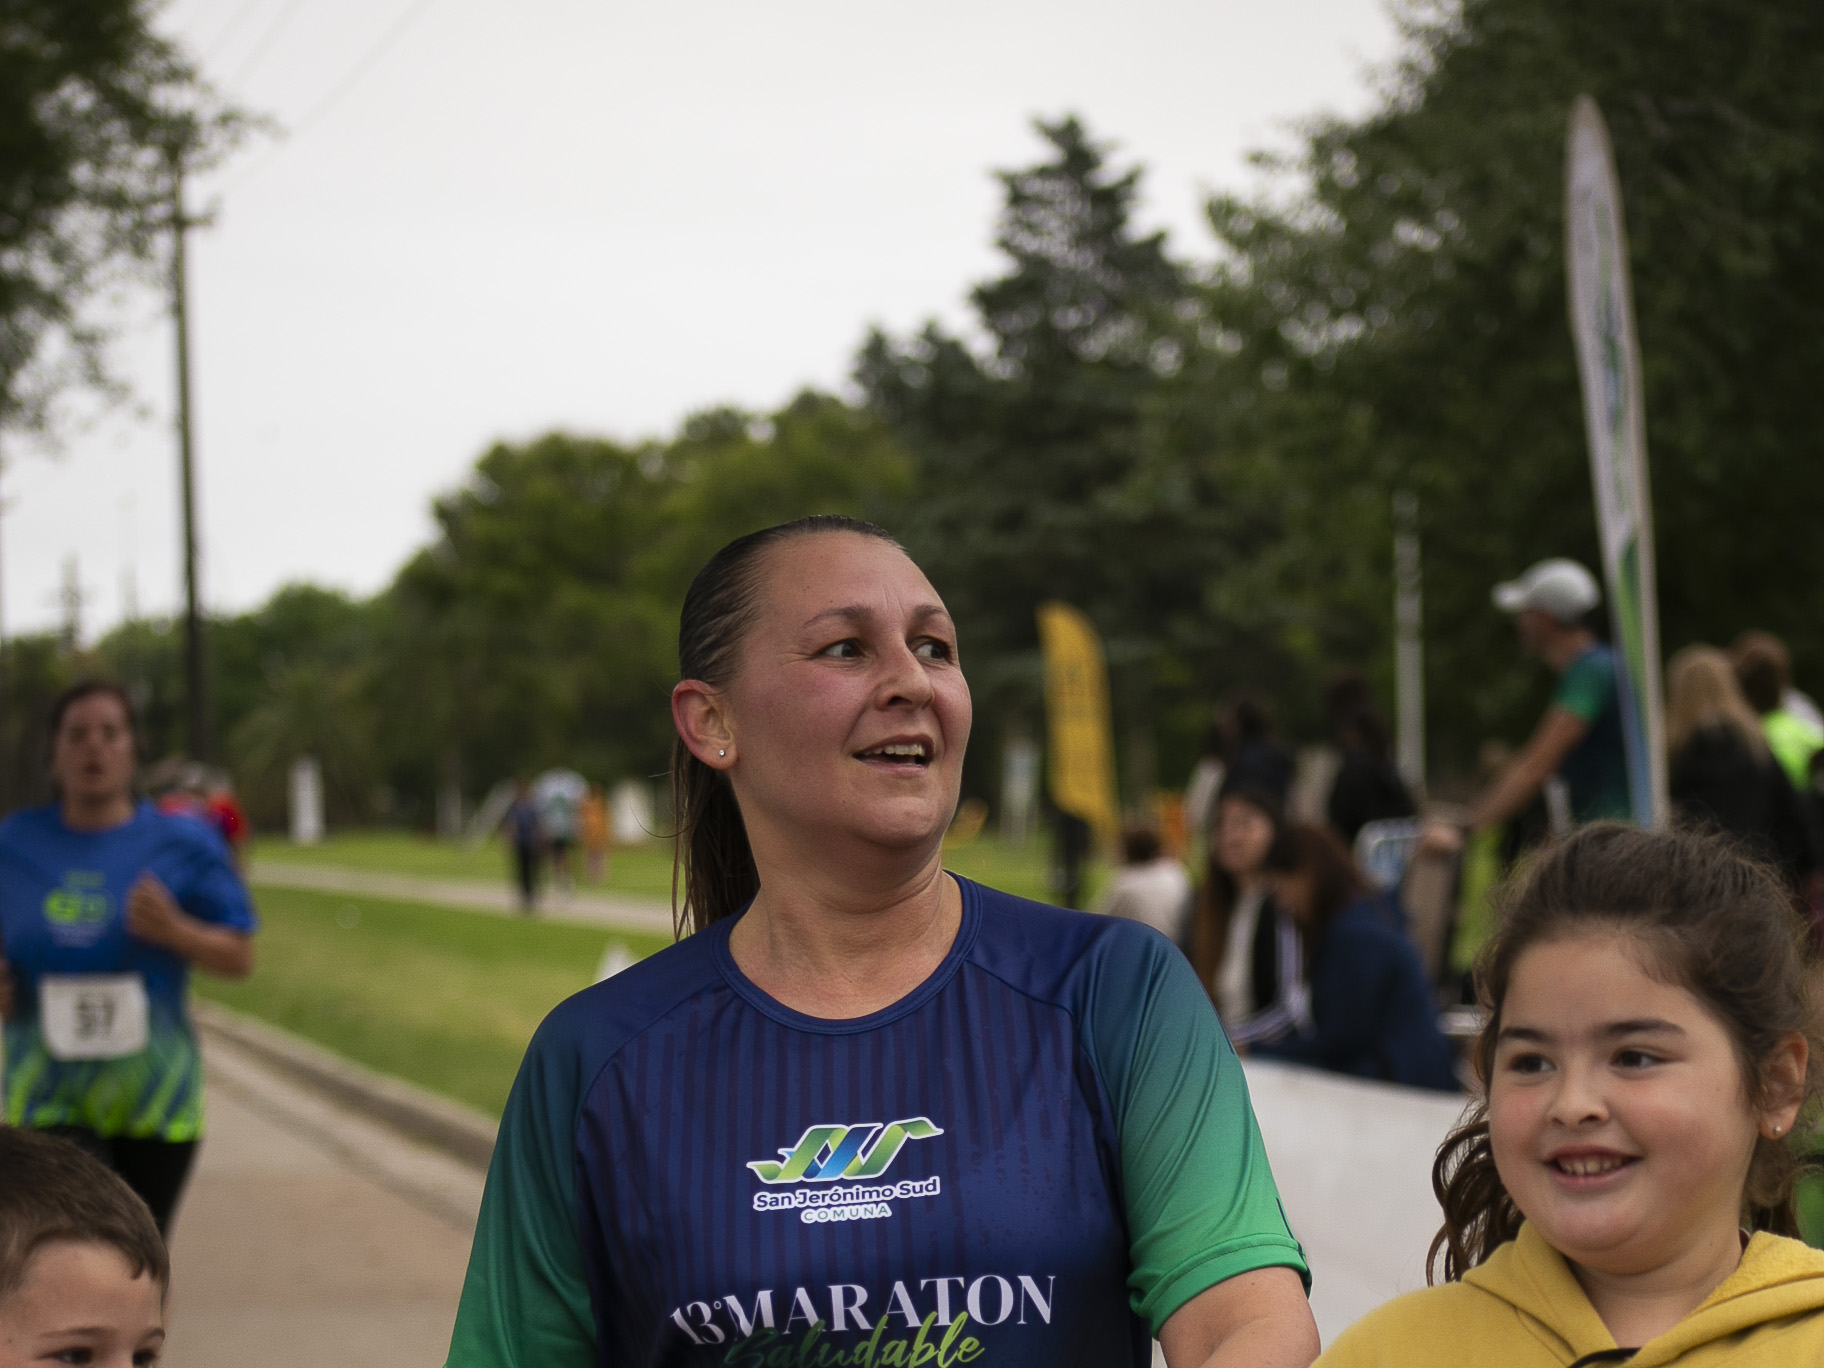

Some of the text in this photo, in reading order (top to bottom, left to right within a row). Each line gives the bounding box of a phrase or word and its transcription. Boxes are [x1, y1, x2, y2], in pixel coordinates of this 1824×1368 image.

[755, 1178, 938, 1208] San Jerónimo Sud
[803, 1204, 890, 1222] COMUNA
